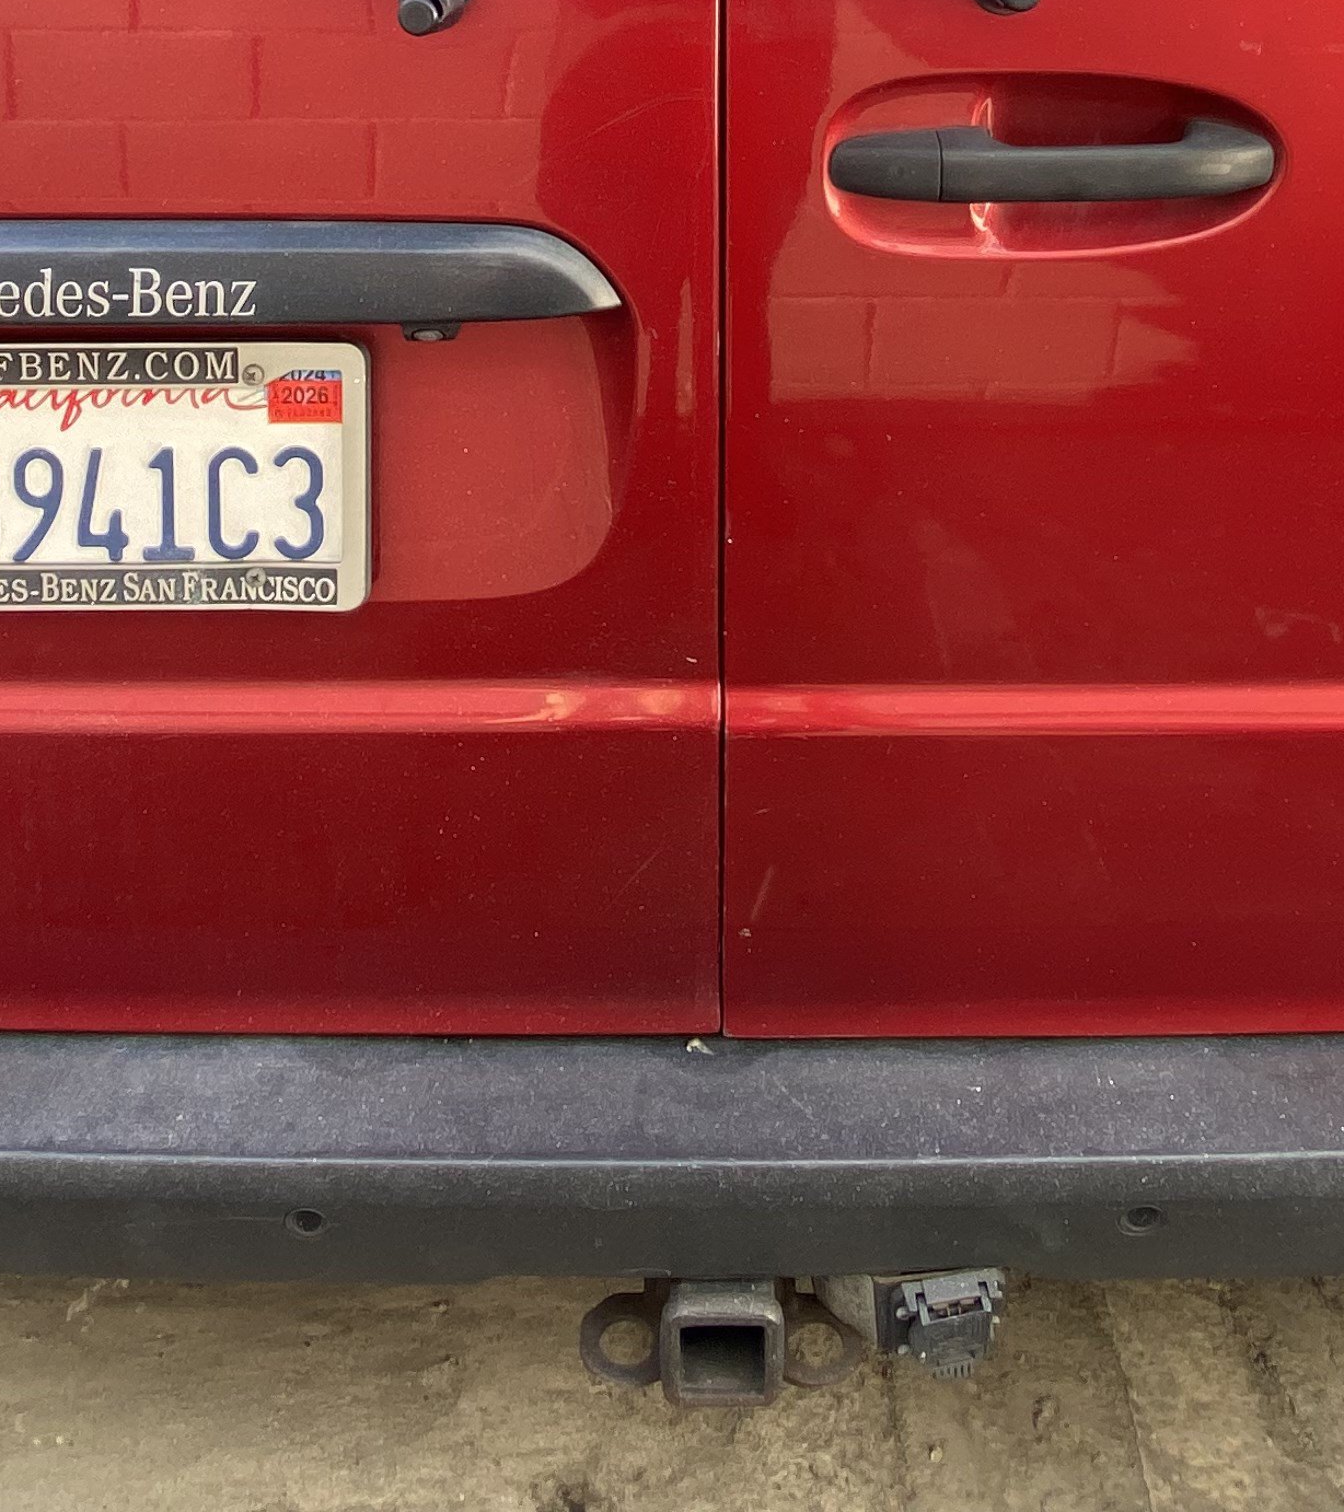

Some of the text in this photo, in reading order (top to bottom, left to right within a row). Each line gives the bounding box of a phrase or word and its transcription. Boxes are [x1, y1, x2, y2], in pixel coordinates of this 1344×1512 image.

[281, 386, 329, 404] 2026
[123, 572, 179, 602] SAN
[182, 570, 336, 603] FRANCISCO
